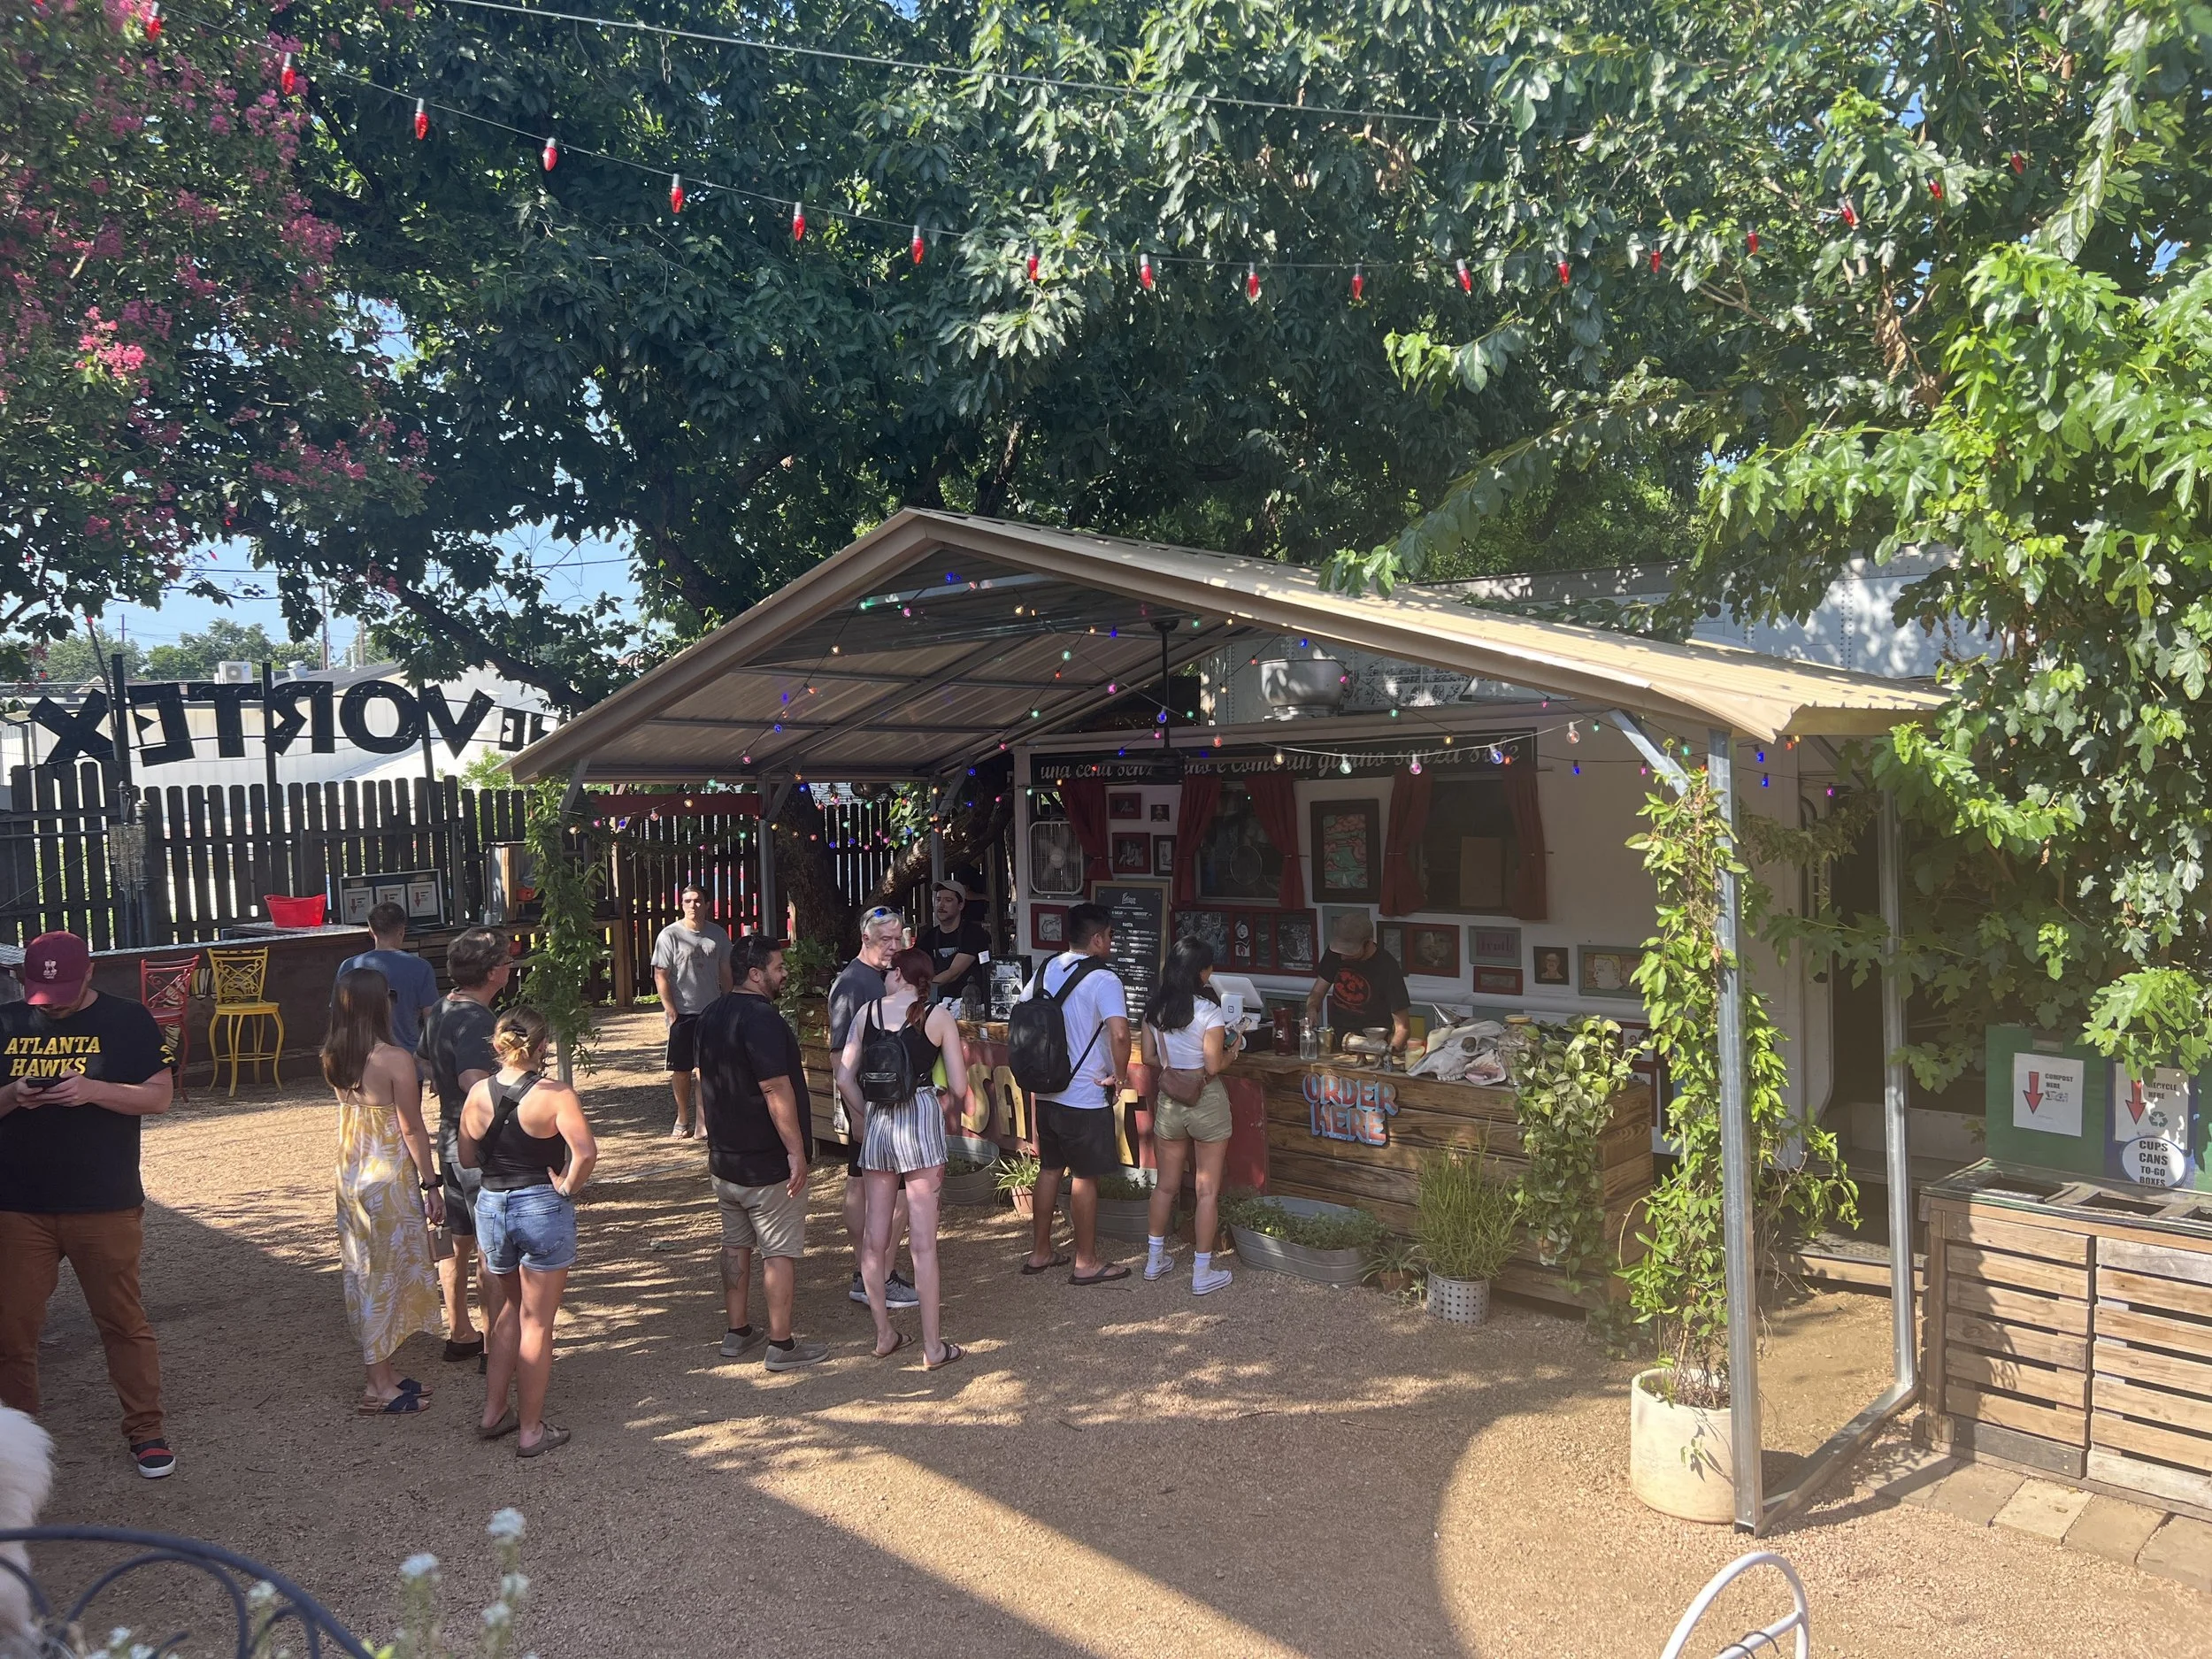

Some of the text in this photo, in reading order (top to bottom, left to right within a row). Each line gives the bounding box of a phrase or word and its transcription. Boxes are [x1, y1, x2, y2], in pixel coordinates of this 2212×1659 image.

[1041, 764, 1071, 780] una
[4, 1036, 101, 1056] ATLANTA
[10, 1056, 88, 1078] HAWKS
[2045, 1073, 2073, 1082] COMPOST
[2147, 1081, 2177, 1091] ECYCLE
[1302, 1072, 1399, 1116] ORDER
[1310, 1102, 1387, 1146] HERE
[2139, 1140, 2168, 1152] CUPS
[2139, 1152, 2168, 1165] CANS
[2140, 1165, 2166, 1177] TO-GO
[2139, 1176, 2166, 1187] BOXES
